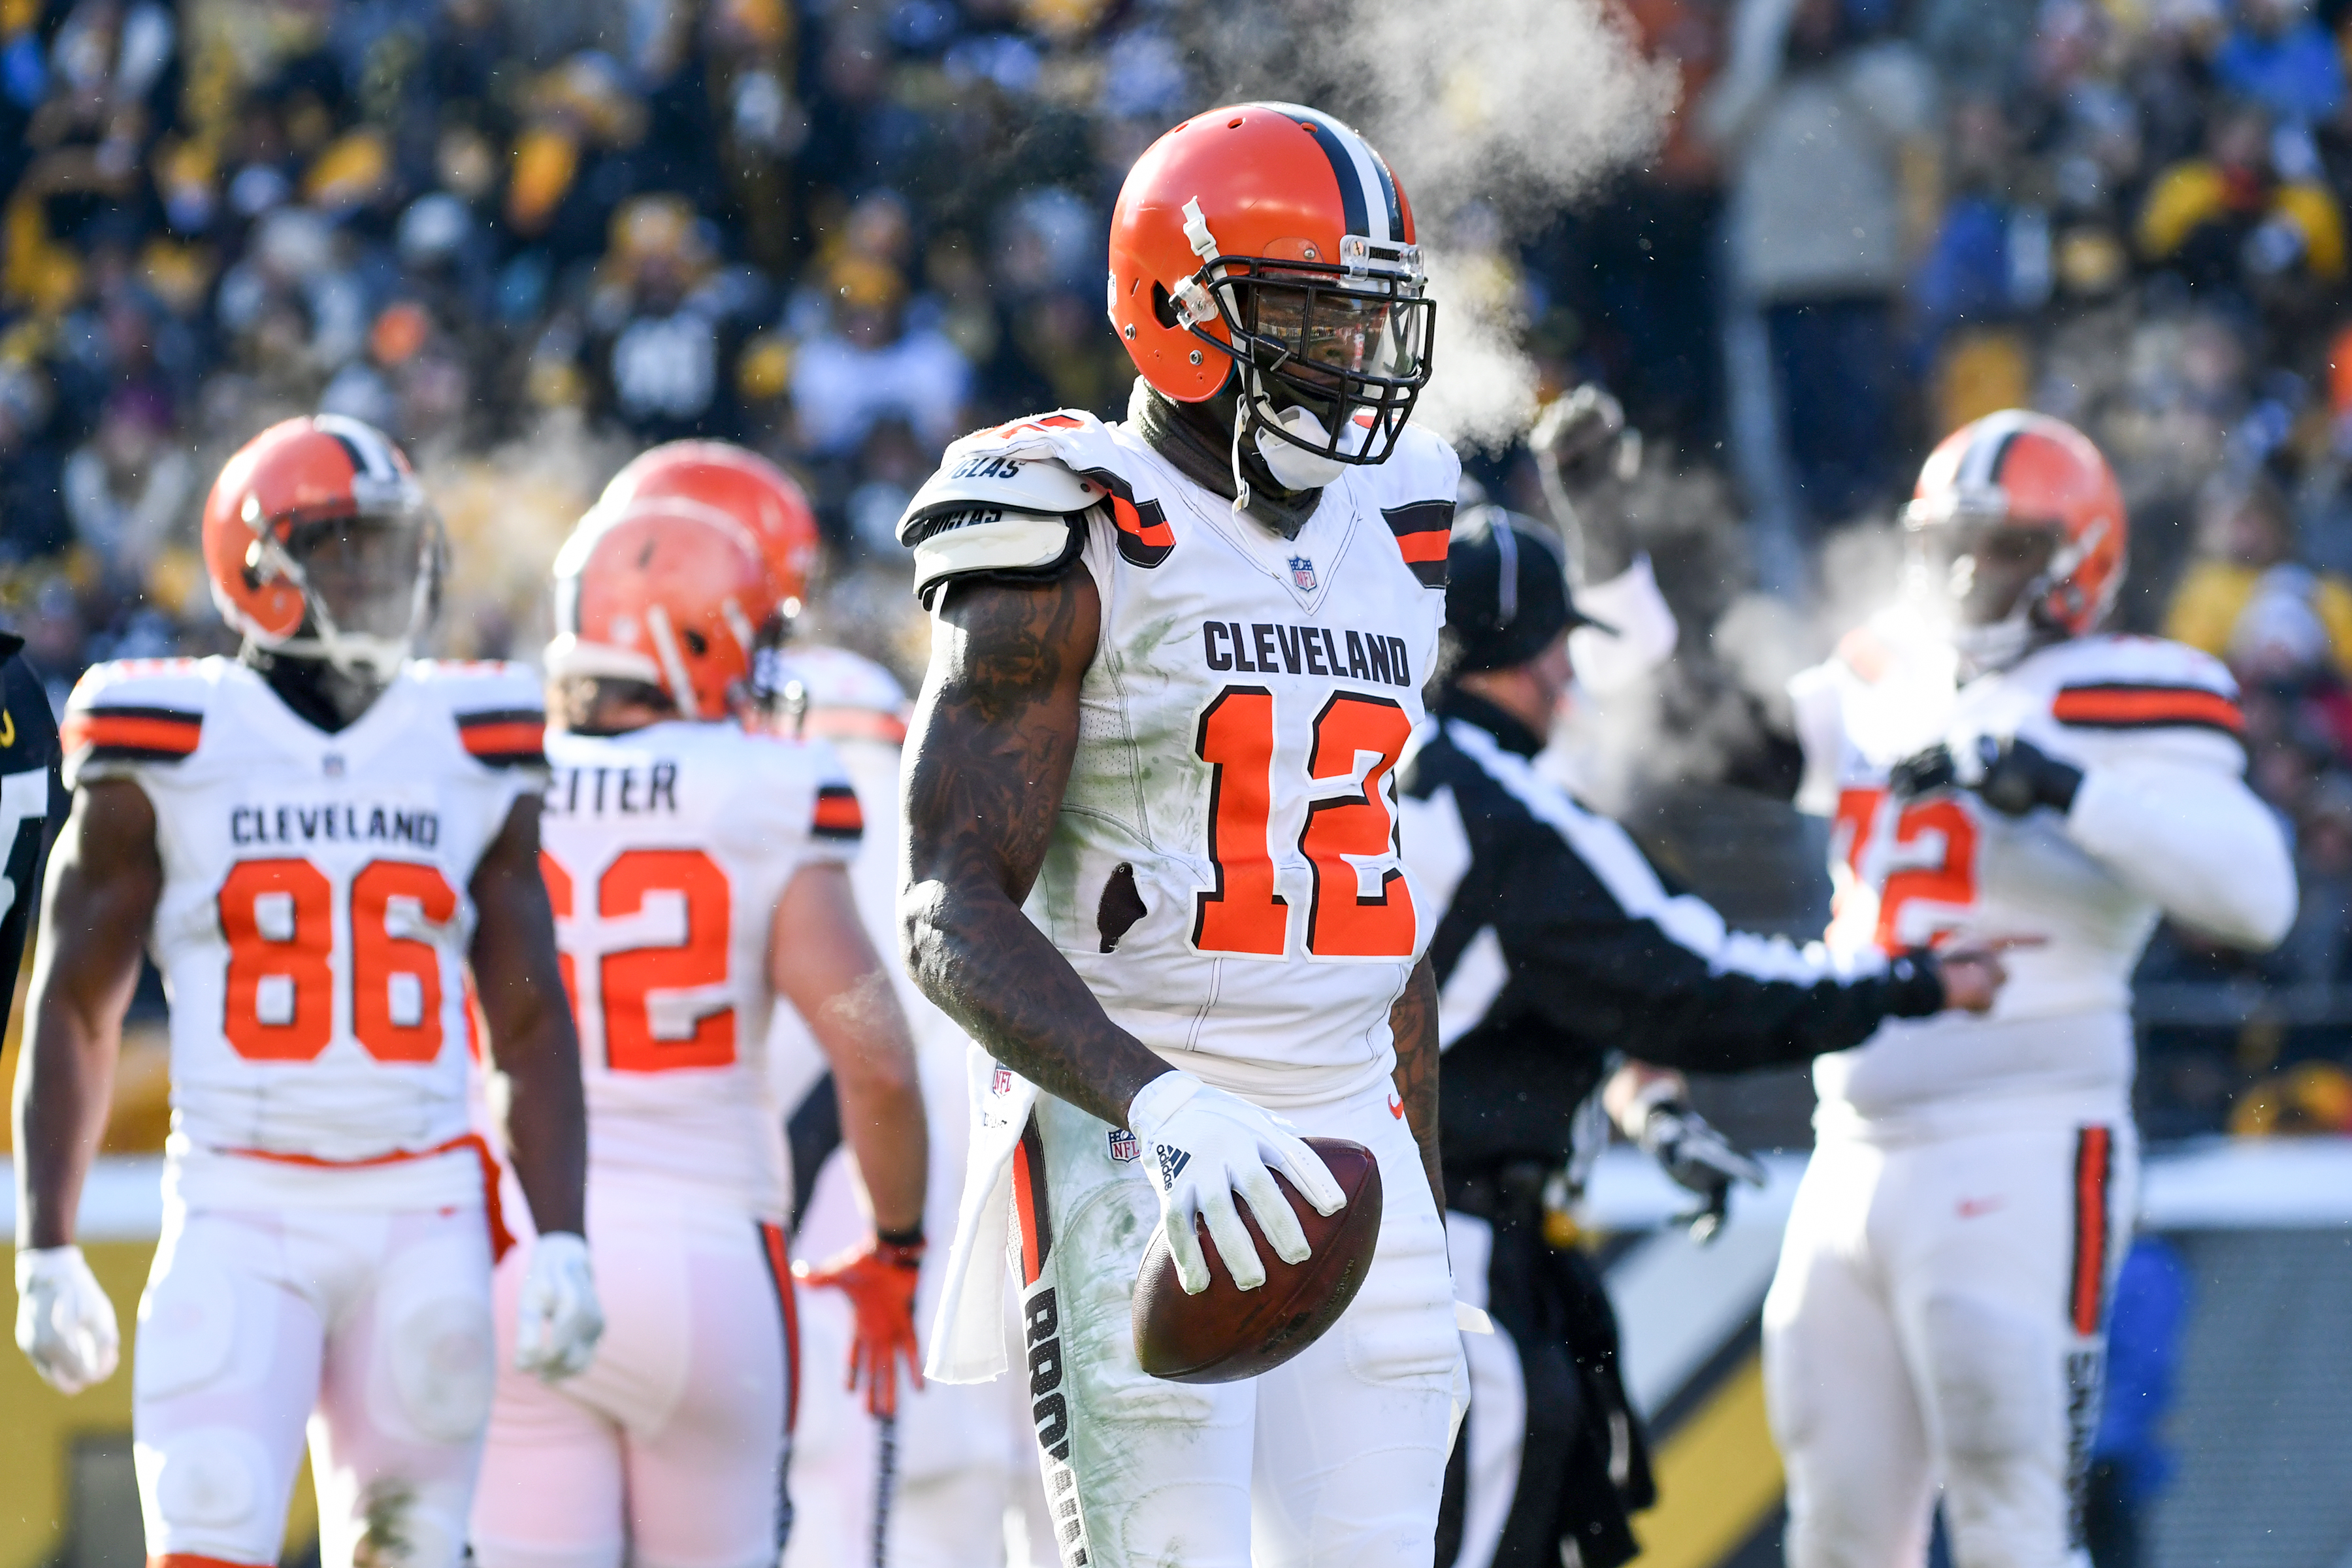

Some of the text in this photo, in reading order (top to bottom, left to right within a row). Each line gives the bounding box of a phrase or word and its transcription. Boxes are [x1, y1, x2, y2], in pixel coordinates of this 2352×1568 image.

[1295, 571, 1315, 588] NFL
[1203, 620, 1411, 687] CLEVELAND
[231, 806, 440, 846] CLEVELAND
[1190, 684, 1417, 956] 12
[217, 857, 457, 1064] 86
[537, 847, 737, 1072] 2
[993, 1070, 1012, 1096] NFL
[1113, 1141, 1140, 1159] NFL
[1156, 1144, 1173, 1191] adidas
